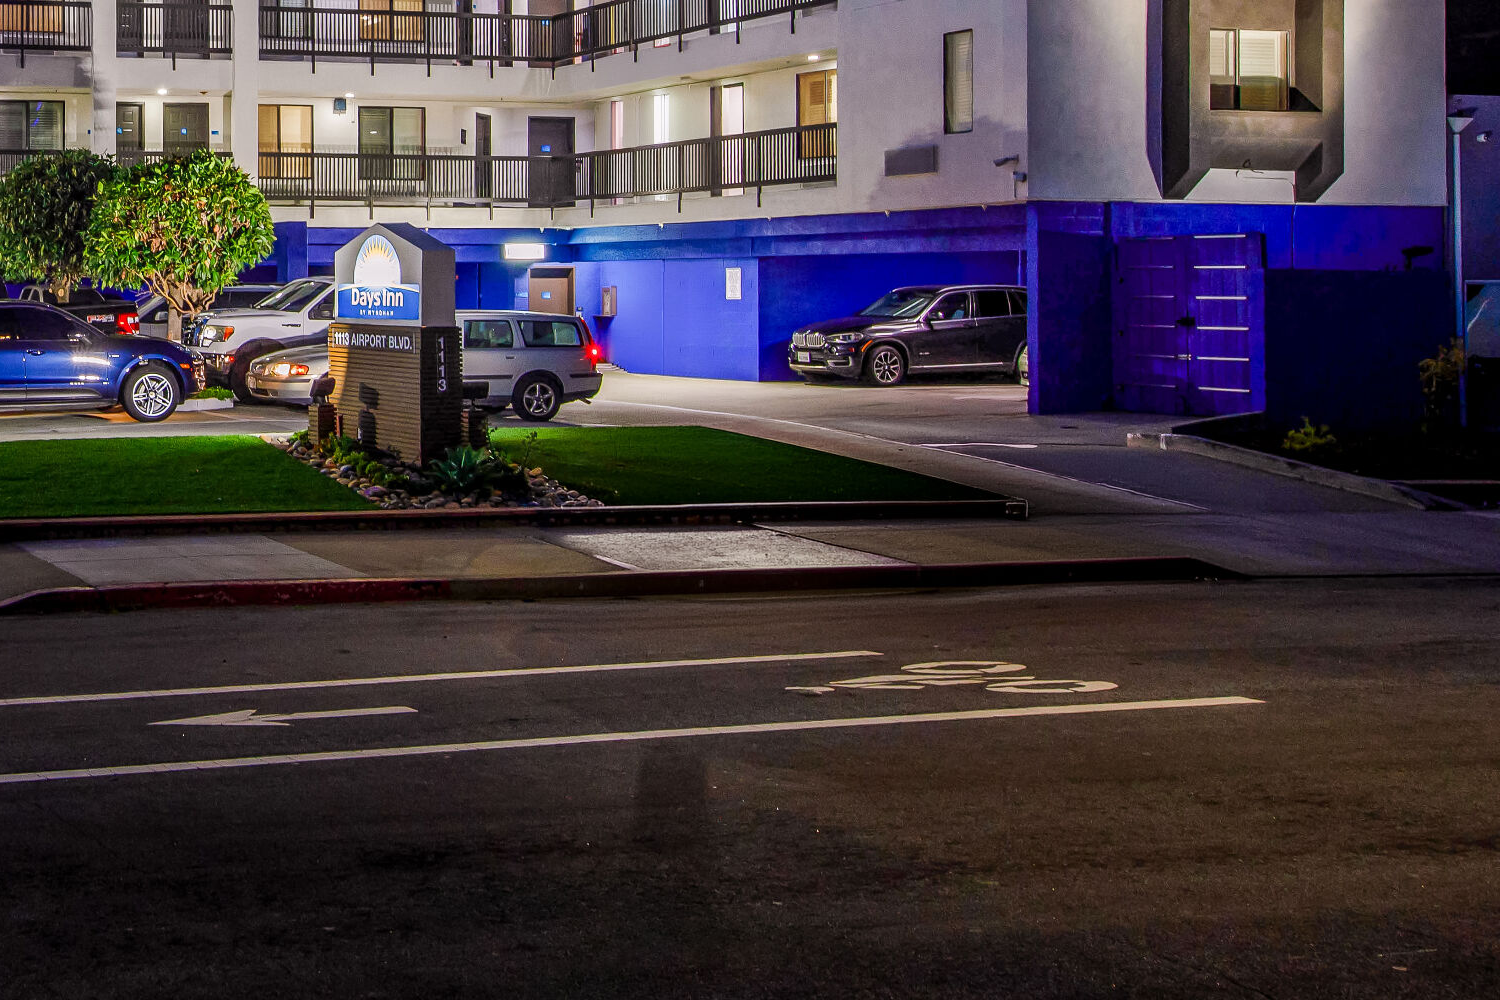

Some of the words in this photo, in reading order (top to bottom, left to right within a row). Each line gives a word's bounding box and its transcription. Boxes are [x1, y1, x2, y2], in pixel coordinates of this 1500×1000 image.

[351, 288, 381, 309] Days
[382, 288, 404, 307] Inn
[334, 331, 350, 346] 1113
[351, 333, 387, 348] AIRPORT
[388, 335, 413, 350] BLVD.
